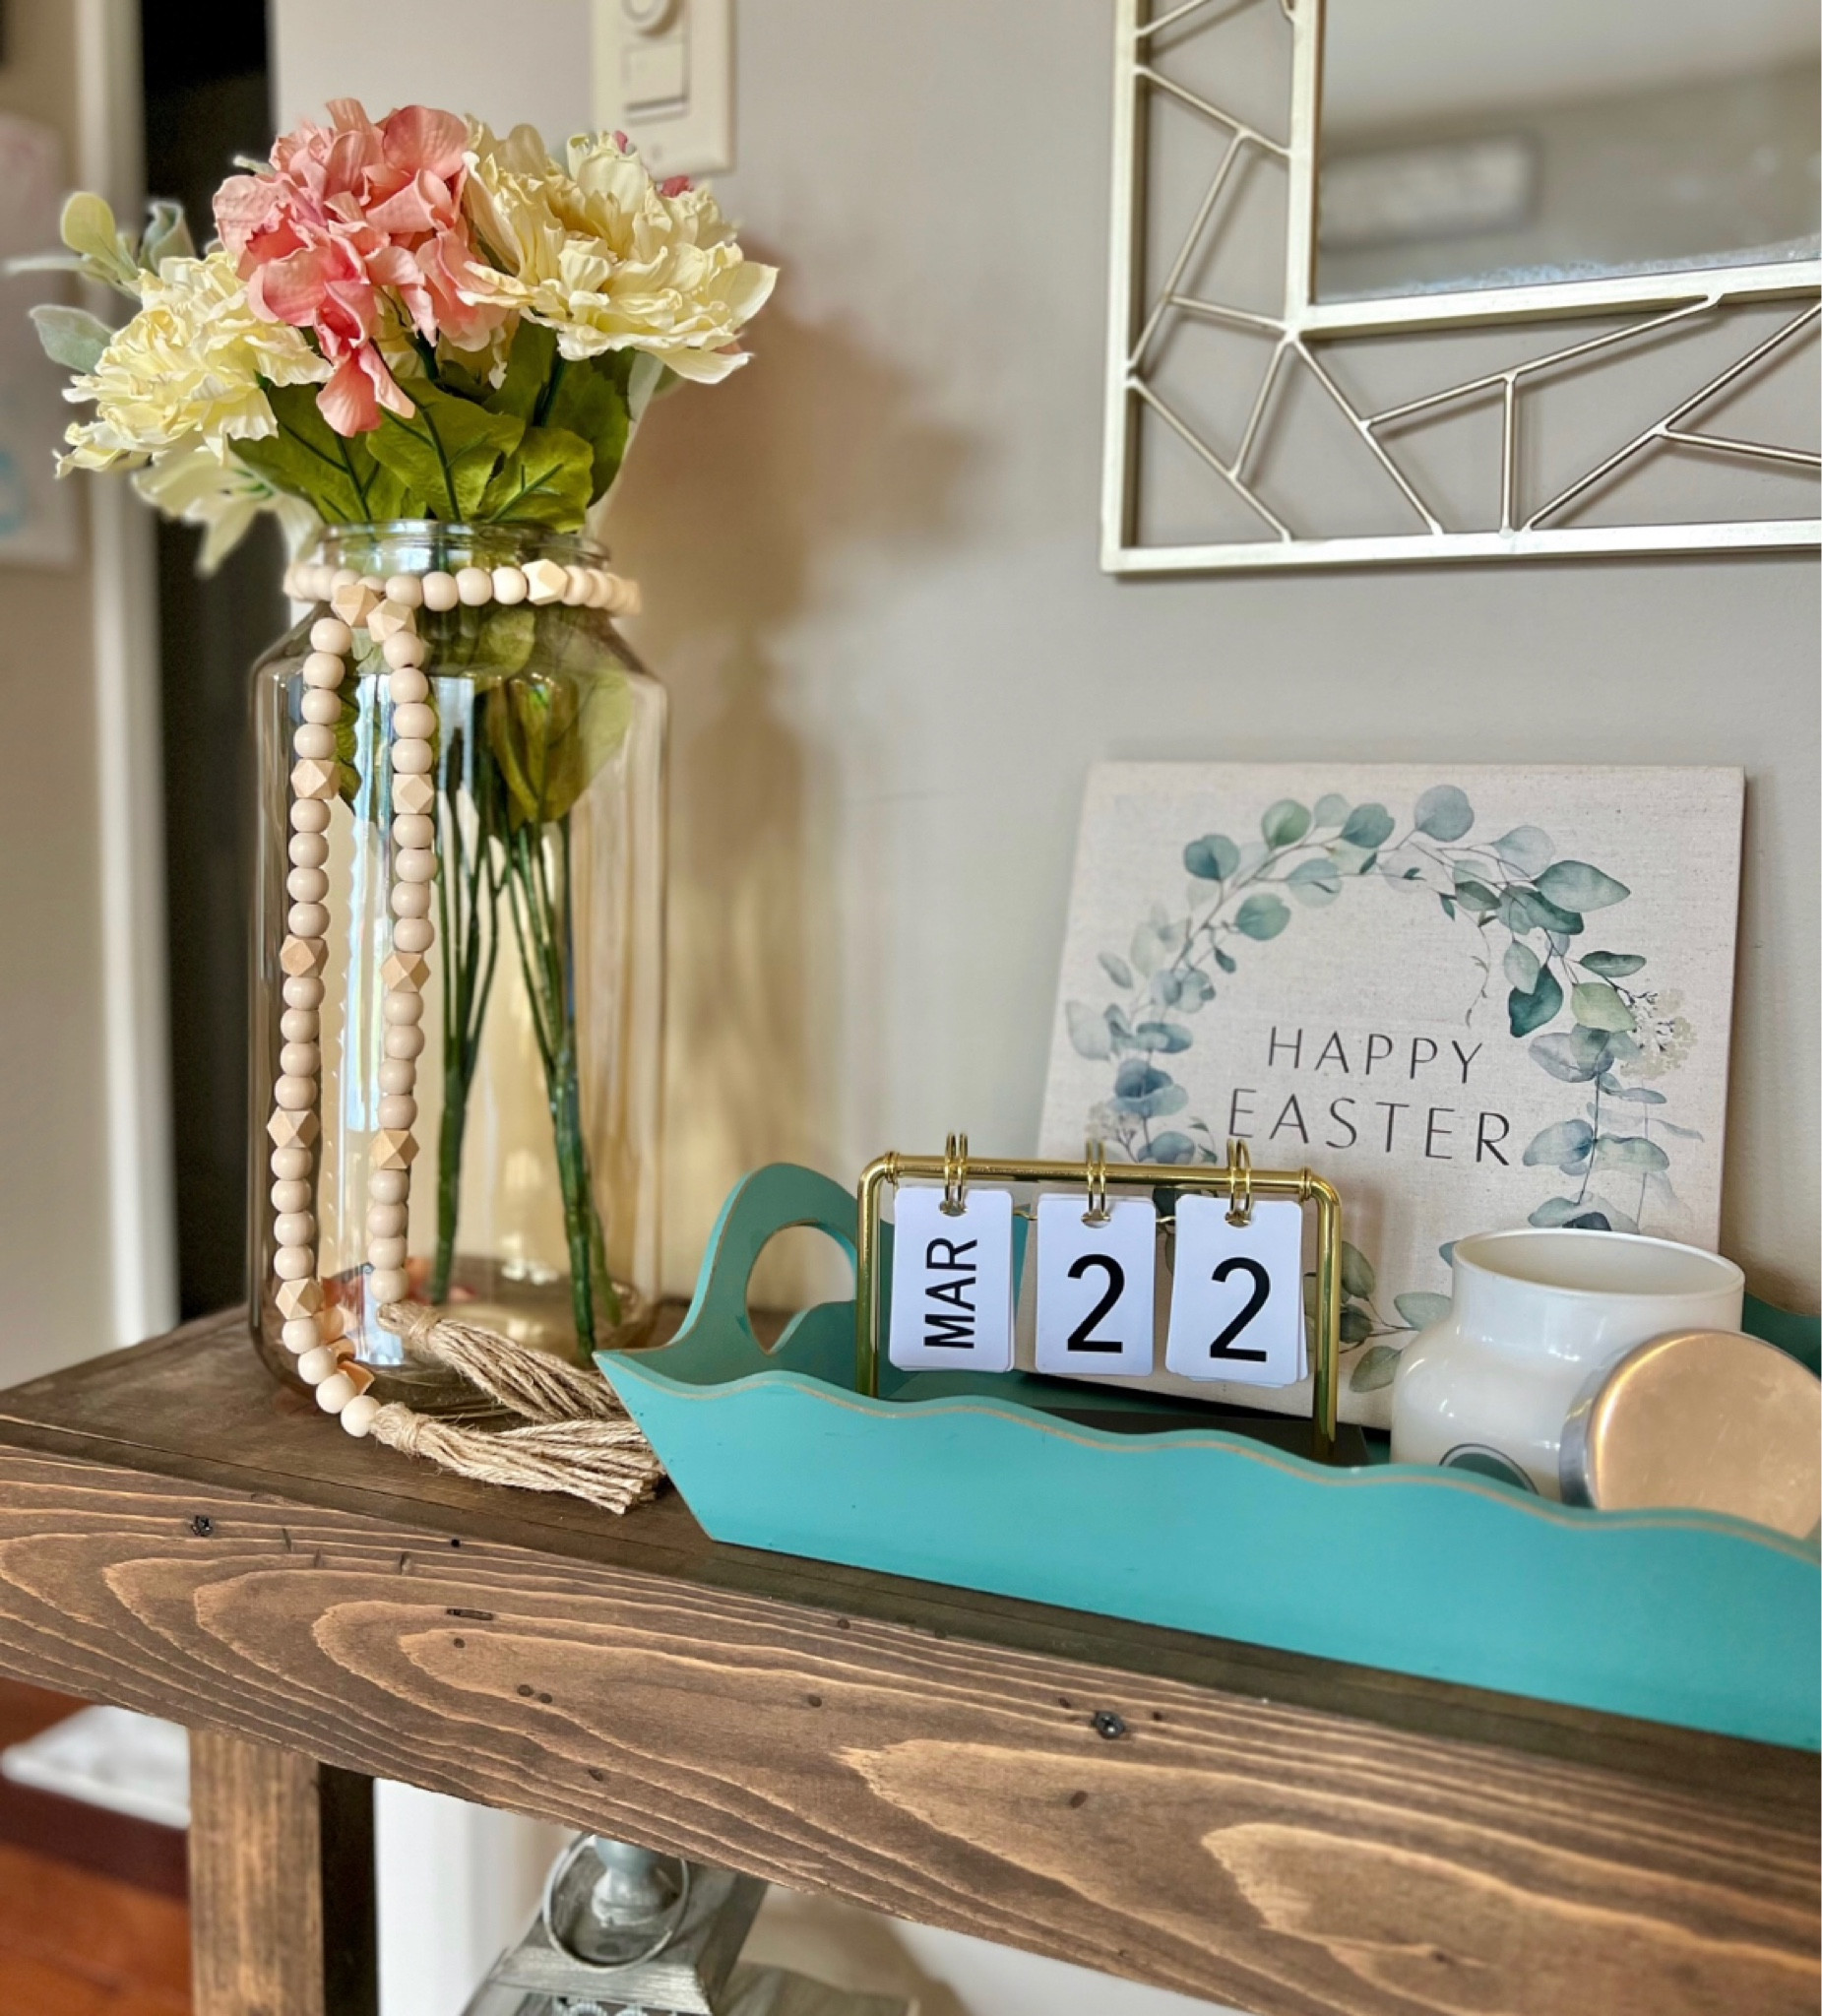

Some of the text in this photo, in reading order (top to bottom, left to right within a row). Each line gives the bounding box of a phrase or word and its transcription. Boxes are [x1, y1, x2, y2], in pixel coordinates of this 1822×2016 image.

[1268, 1026, 1482, 1084] HAPPY
[1228, 1088, 1510, 1166] EASTER
[922, 1236, 1272, 1362] MAR 2 2
